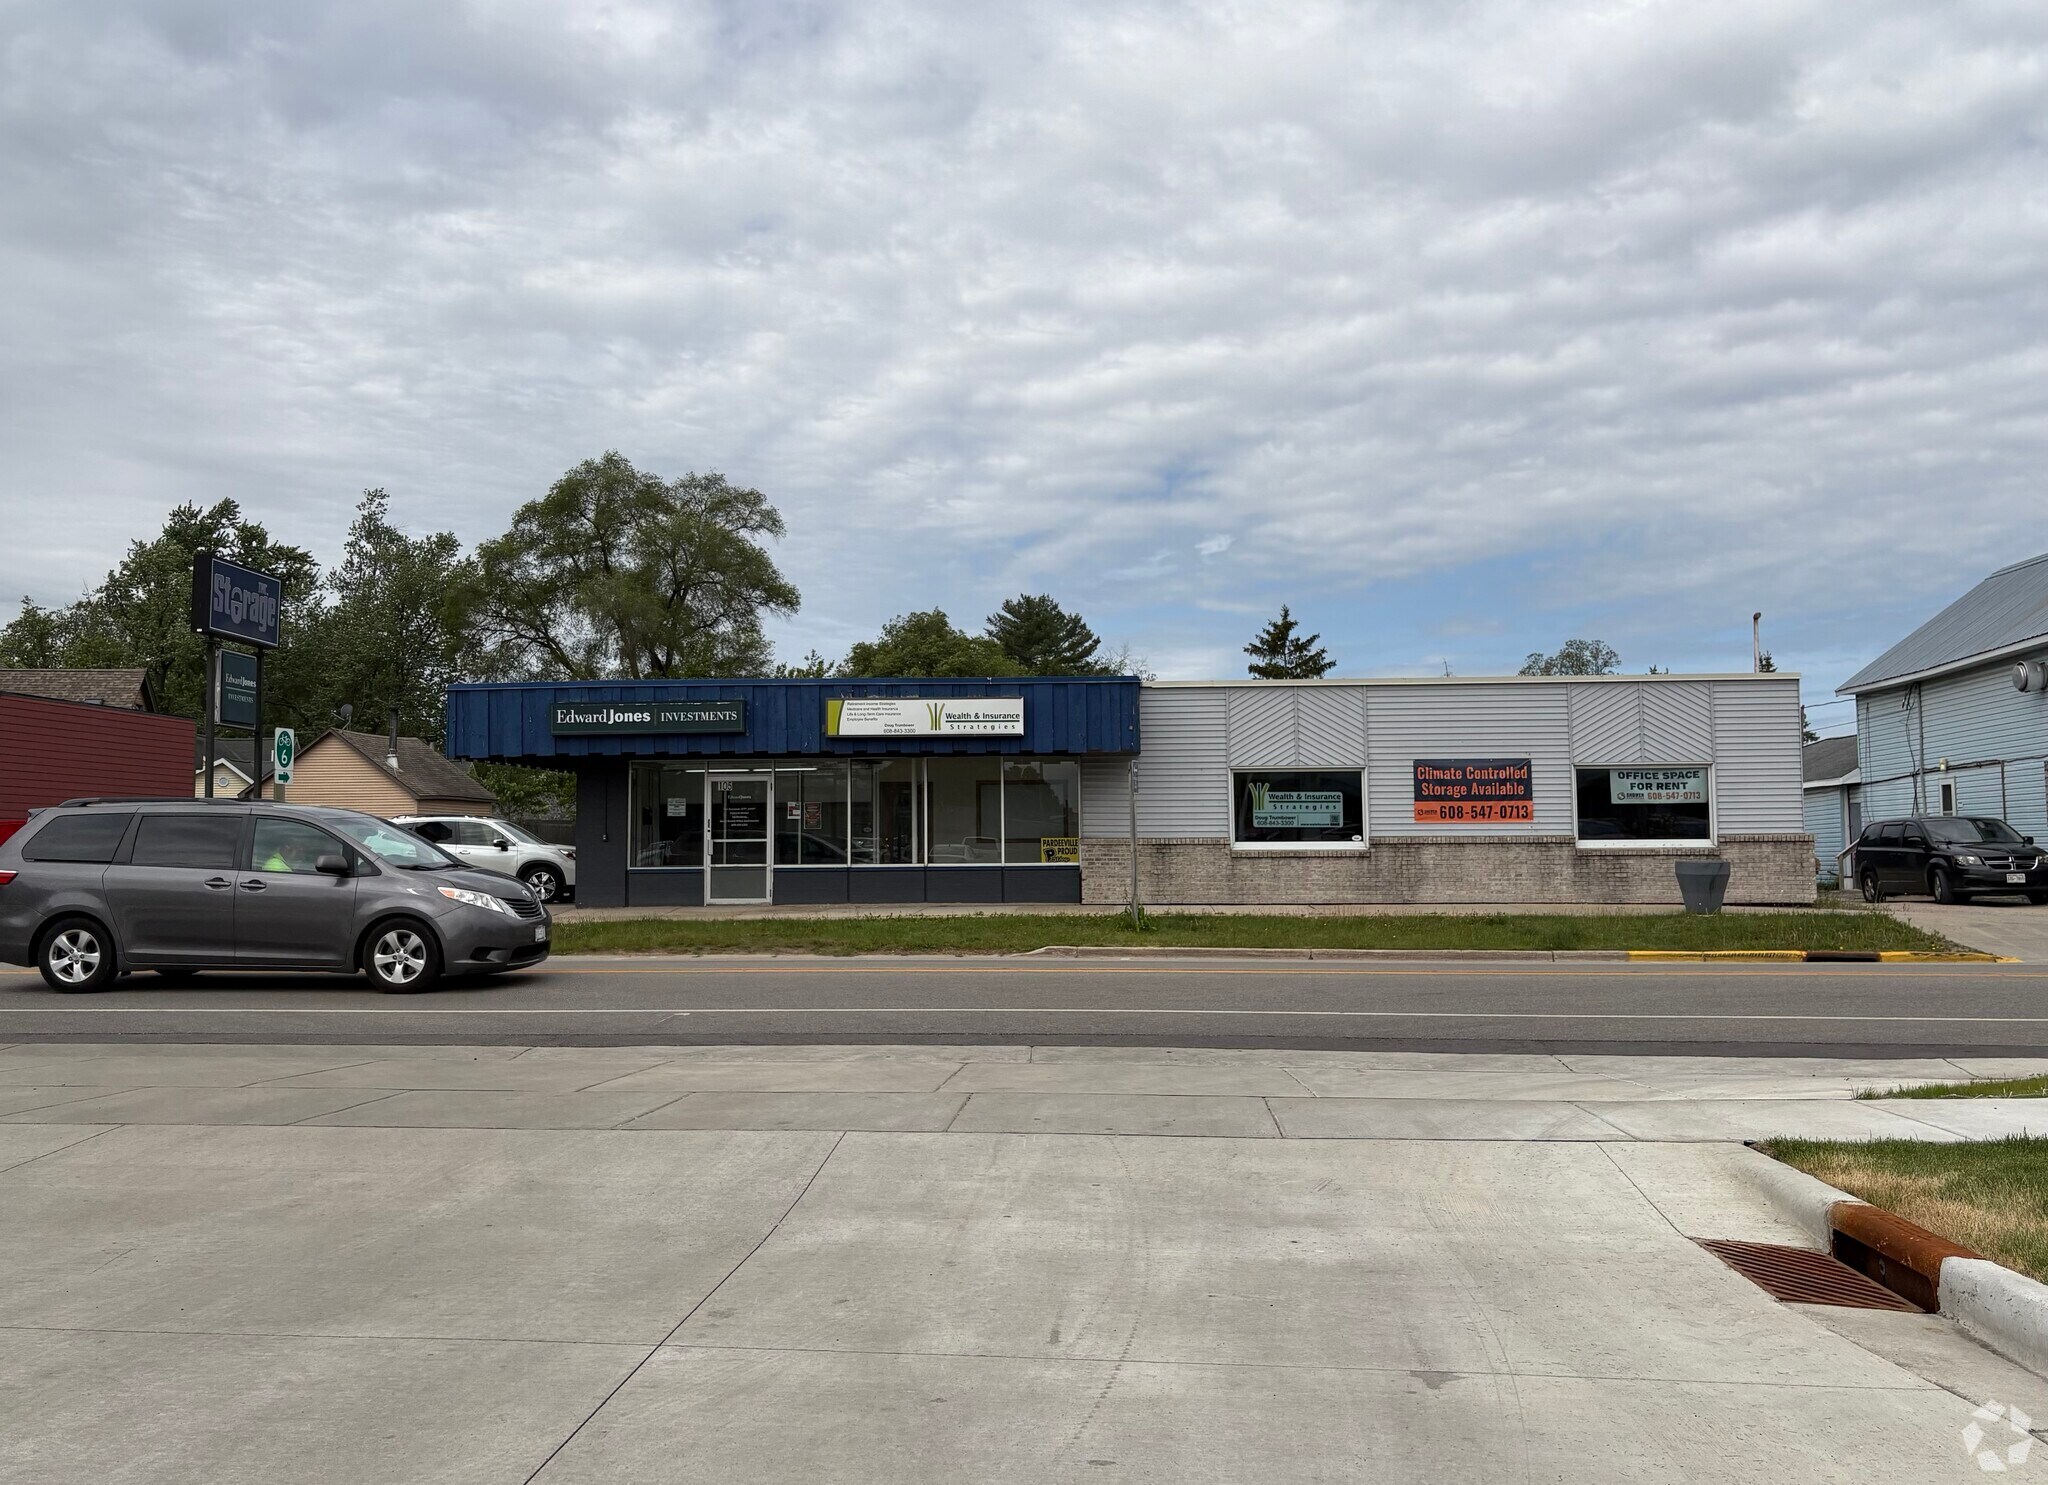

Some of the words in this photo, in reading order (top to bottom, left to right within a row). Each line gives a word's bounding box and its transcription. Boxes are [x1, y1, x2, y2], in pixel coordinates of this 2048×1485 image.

[213, 573, 276, 632] Storage
[660, 711, 738, 722] INVESTMENTS
[945, 712, 972, 720] Wealth
[974, 712, 980, 720] &
[982, 712, 1020, 720] Insurance
[281, 749, 288, 764] 6
[1417, 766, 1462, 780] Climate
[1466, 765, 1528, 779] Controlled
[1617, 771, 1660, 780] OFFICE
[1662, 770, 1700, 779] SPACE
[1421, 782, 1467, 798] Storage
[1471, 782, 1525, 795] Available
[1630, 782, 1653, 790] FOR
[1656, 782, 1688, 790] RENT
[1647, 792, 1701, 800] 608-547-0713
[1440, 805, 1529, 819] 608-547-0713
[1042, 839, 1079, 847] PARDEEVILLE
[1057, 847, 1078, 855] PROUD
